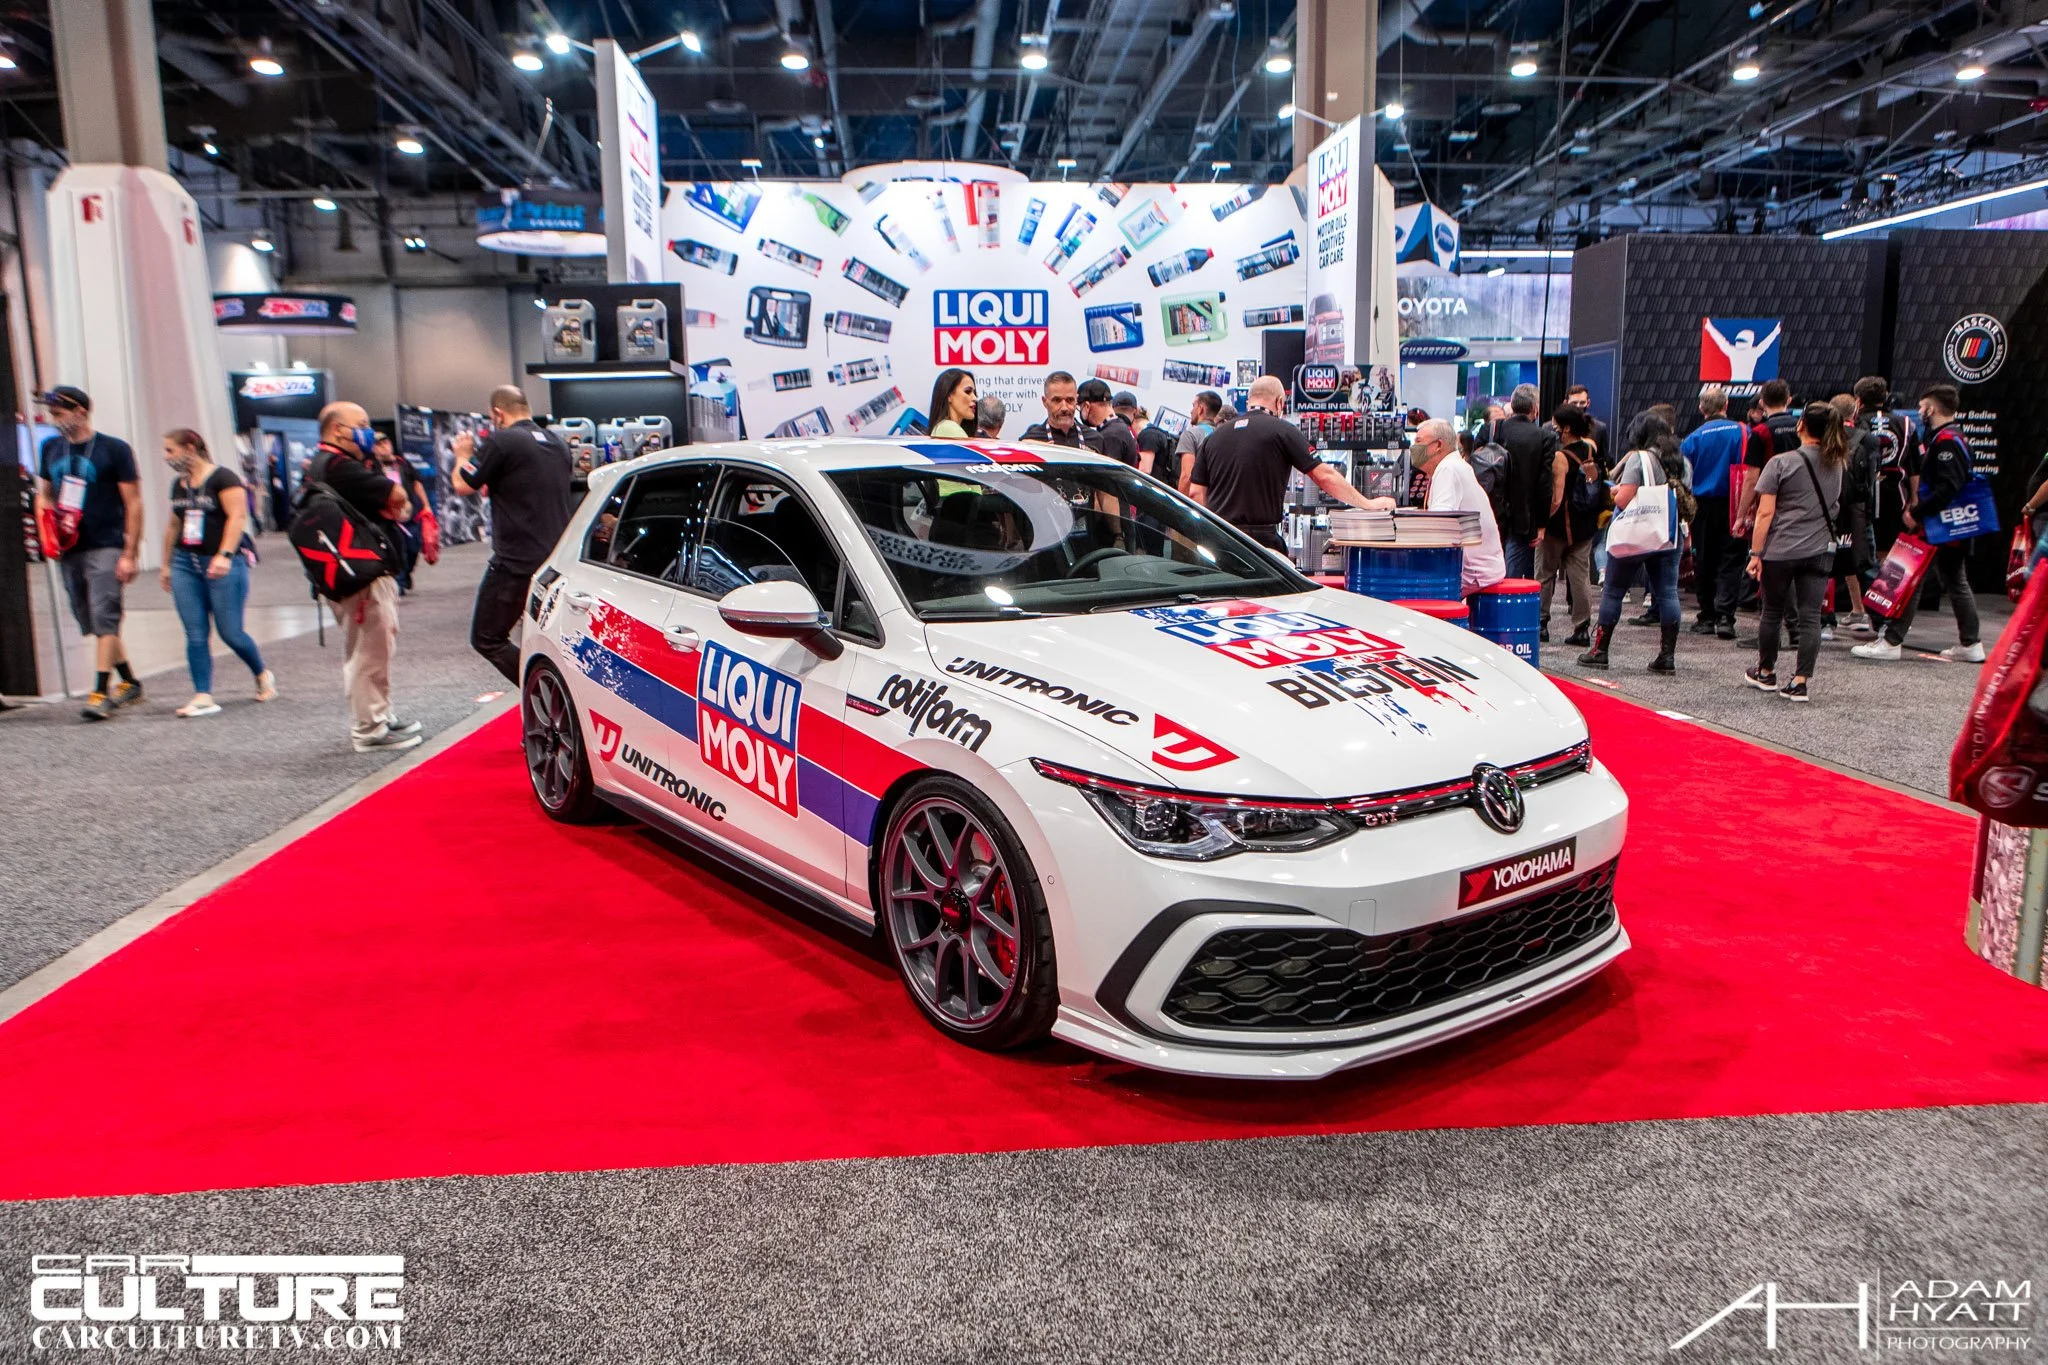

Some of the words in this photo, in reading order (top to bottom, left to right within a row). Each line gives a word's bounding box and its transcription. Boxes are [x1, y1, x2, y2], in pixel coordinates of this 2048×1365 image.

[1319, 138, 1348, 186] LIQUI
[1319, 172, 1348, 216] MOLY
[1317, 220, 1335, 240] MOTOR
[1335, 212, 1347, 233] OILS
[1318, 231, 1345, 254] ADDITIVES
[1319, 255, 1330, 270] CAR
[1330, 247, 1344, 264] CARE
[938, 291, 1043, 327] LIQUI
[1398, 297, 1468, 315] OYOTA
[1954, 317, 1999, 336] NASCAR
[939, 329, 1048, 364] MOLY
[1401, 346, 1461, 356] SUPERTECH
[1947, 343, 1980, 380] COMPETITION
[1981, 343, 2004, 377] PARTNER
[975, 376, 992, 387] ing
[995, 376, 1014, 385] that
[1306, 369, 1334, 379] LIQUI
[1306, 379, 1335, 389] MOLY
[1016, 389, 1038, 398] with
[1005, 403, 1023, 412] OLY
[1297, 402, 1327, 410] MADE
[1328, 402, 1338, 410] IN
[1968, 410, 1997, 420] Bodies
[1962, 423, 1992, 433] Wheels
[1968, 437, 1998, 446] Gasket
[1975, 451, 1996, 460] Tires
[1940, 503, 1979, 524] EBC
[1164, 611, 1342, 645] LIQUI
[1214, 629, 1396, 667] MOLY
[1515, 643, 1532, 655] OIL
[945, 656, 1140, 726] UNITRONIC
[1266, 655, 1481, 710] BILSTEIN
[701, 647, 796, 744] LIQUI
[876, 673, 993, 753] rotiform
[701, 708, 795, 806] MOLY
[620, 743, 728, 822] UNITRONIC
[1365, 812, 1398, 827] GTI
[1492, 846, 1572, 892] YOKOHAMA
